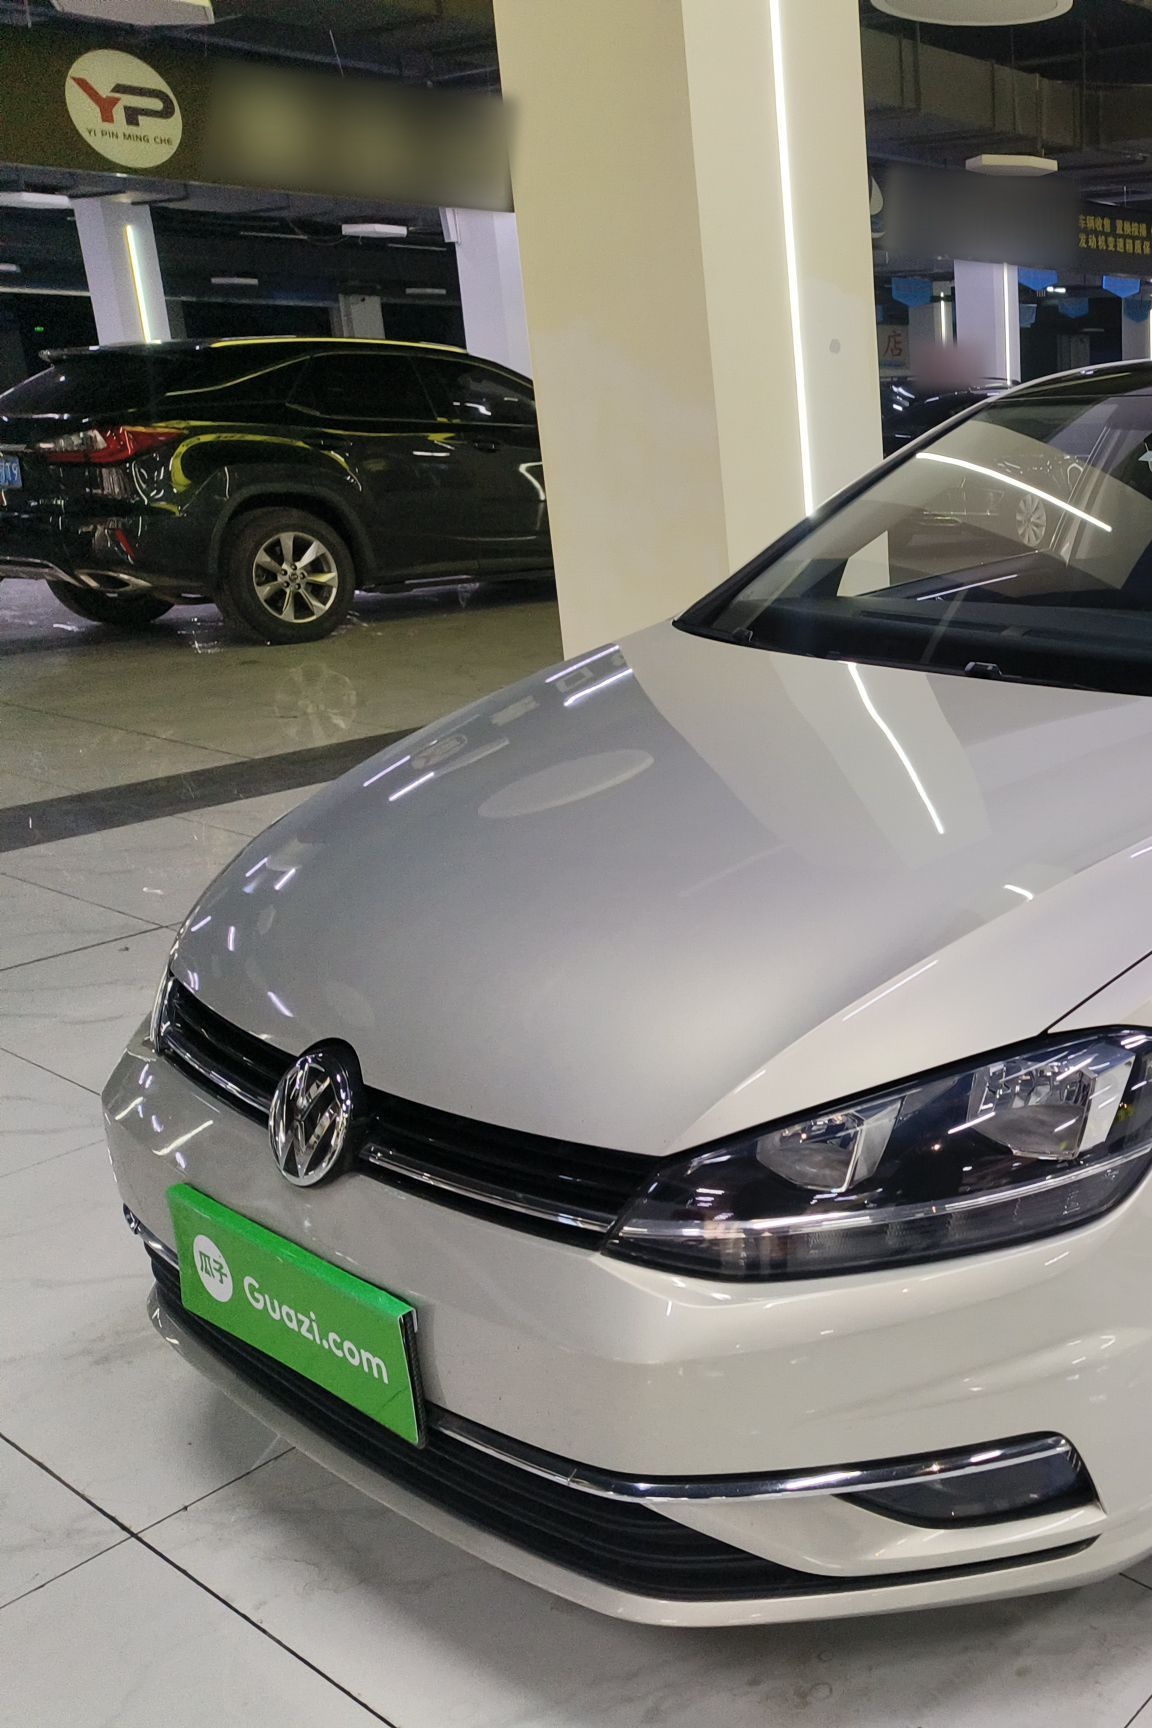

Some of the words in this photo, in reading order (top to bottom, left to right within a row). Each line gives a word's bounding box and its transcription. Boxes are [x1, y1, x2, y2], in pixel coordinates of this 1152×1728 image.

[70, 76, 176, 127] YP
[87, 128, 97, 137] YI
[101, 130, 119, 140] PIN
[123, 132, 150, 143] MING
[153, 135, 173, 146] CHE
[199, 1251, 228, 1285] 瓜子
[243, 1275, 389, 1385] Guazi.com
